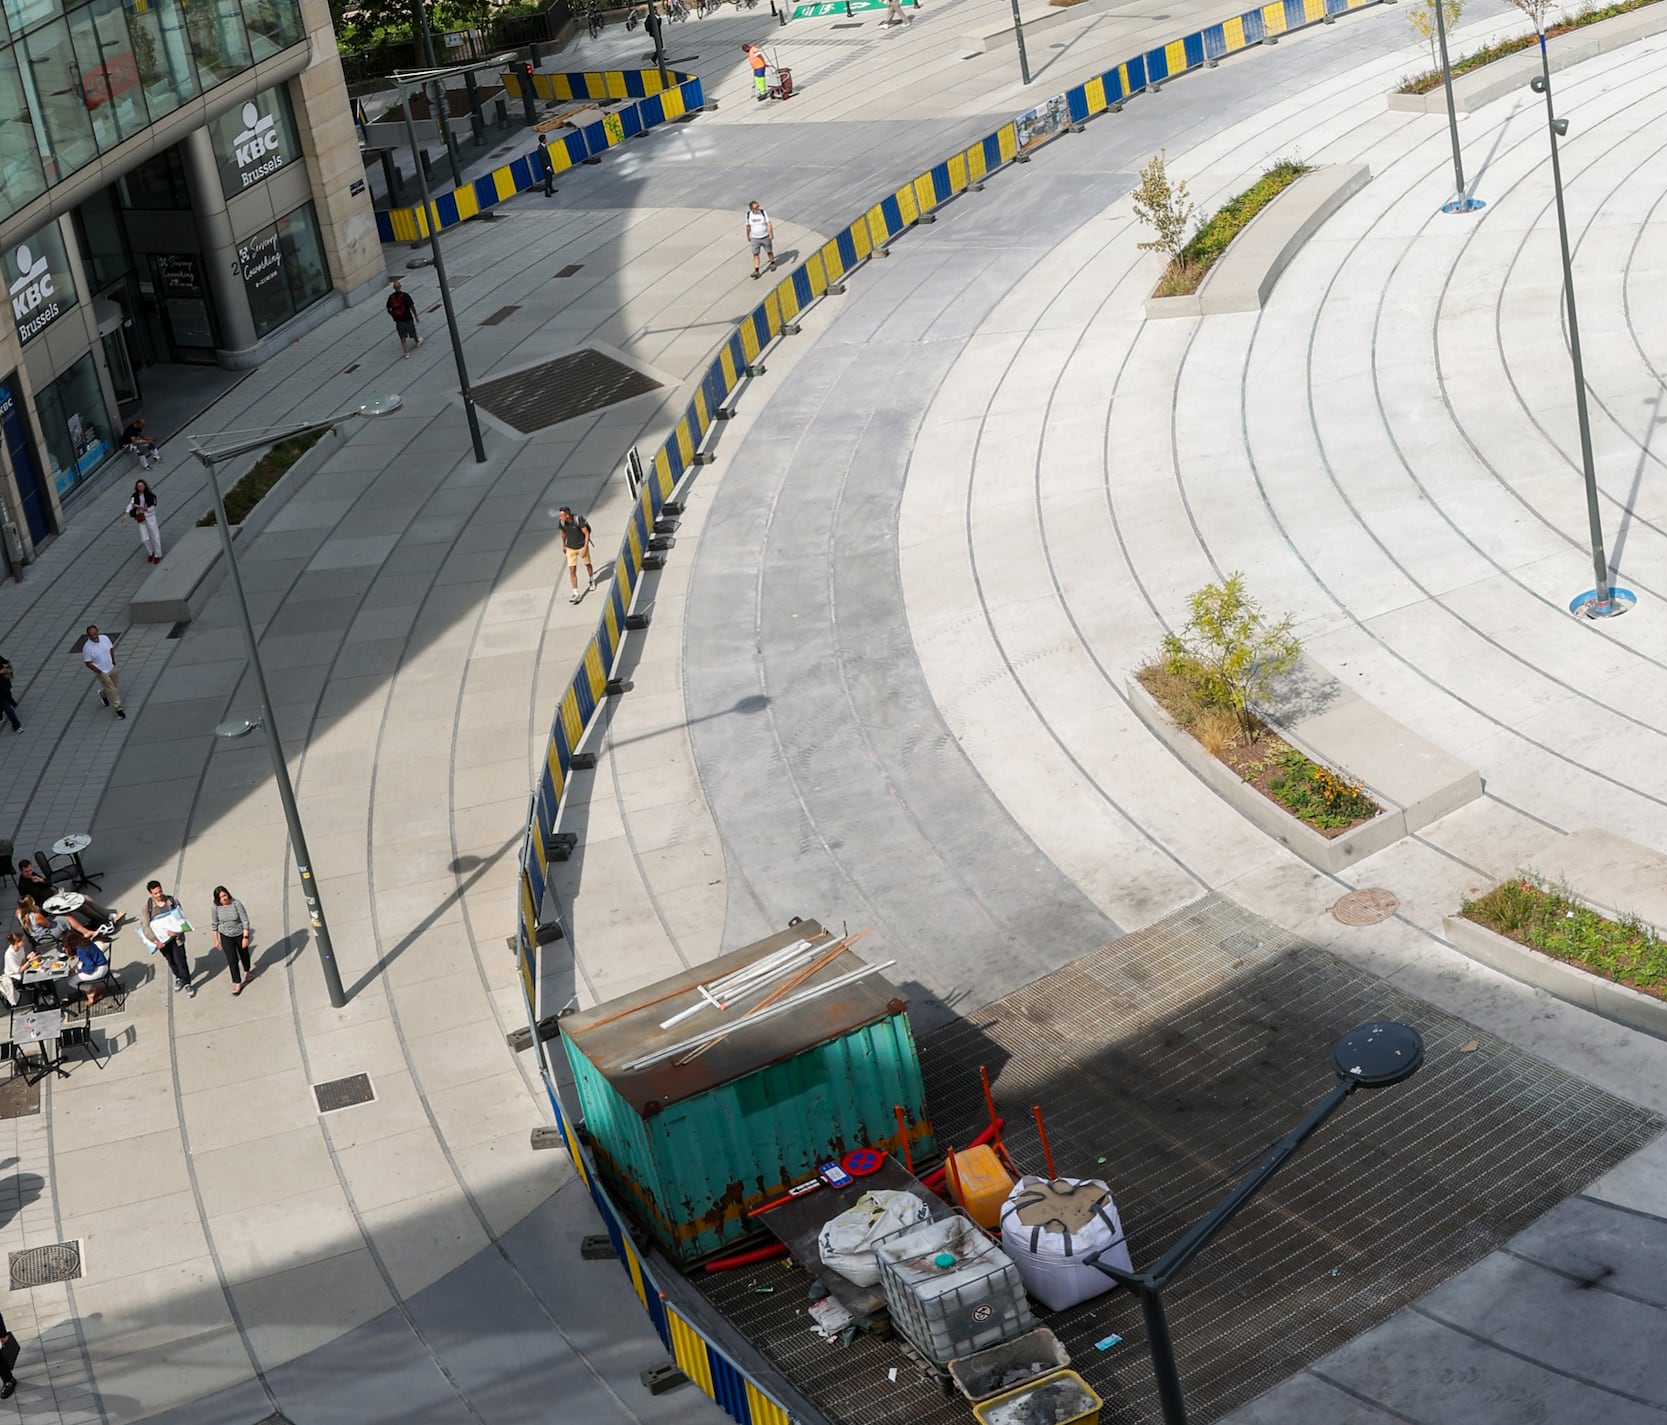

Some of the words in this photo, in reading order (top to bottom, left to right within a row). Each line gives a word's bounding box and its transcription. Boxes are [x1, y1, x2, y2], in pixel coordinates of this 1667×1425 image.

[235, 129, 280, 168] KBC
[241, 154, 284, 188] Brussels
[231, 263, 240, 277] 2
[12, 272, 55, 321] KBC
[19, 301, 60, 342] Brussels
